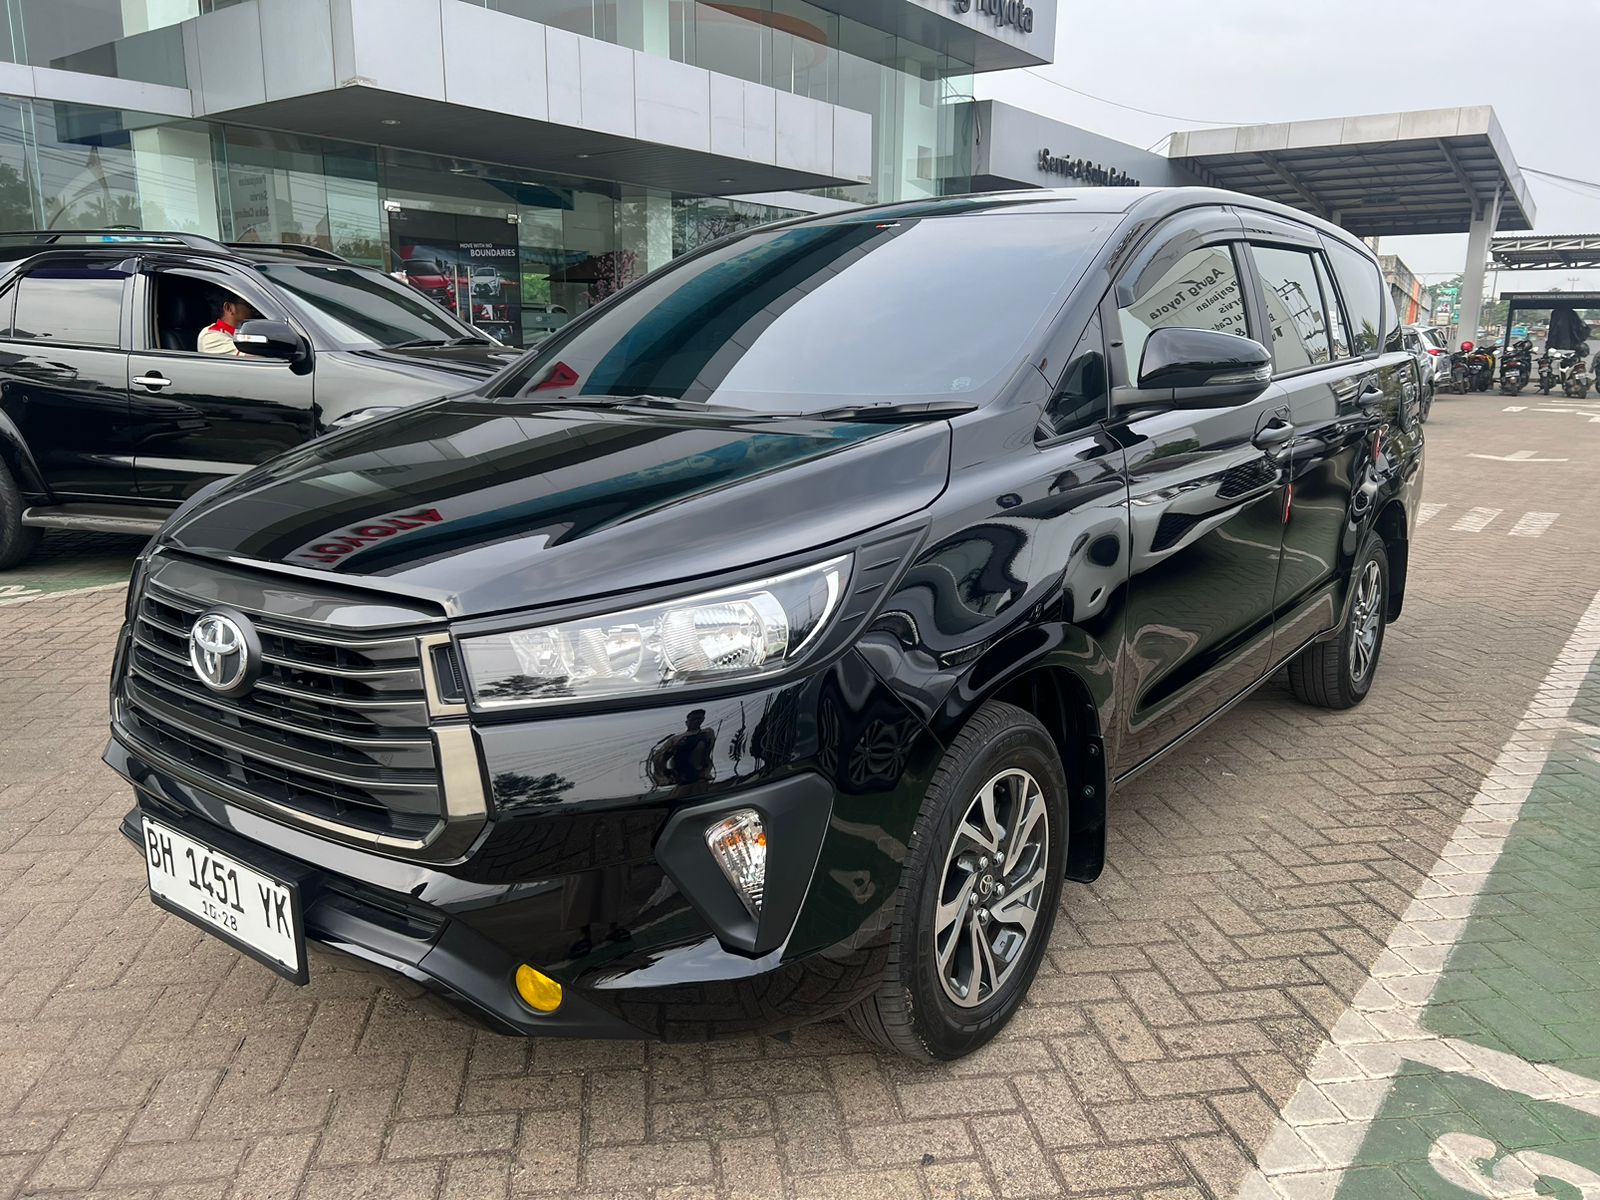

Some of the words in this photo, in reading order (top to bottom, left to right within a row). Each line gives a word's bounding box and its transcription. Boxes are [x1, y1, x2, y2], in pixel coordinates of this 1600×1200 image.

[470, 248, 516, 257] BOUNDARIES
[146, 827, 176, 878] BH
[185, 846, 245, 915] 1451
[257, 881, 292, 940] YK
